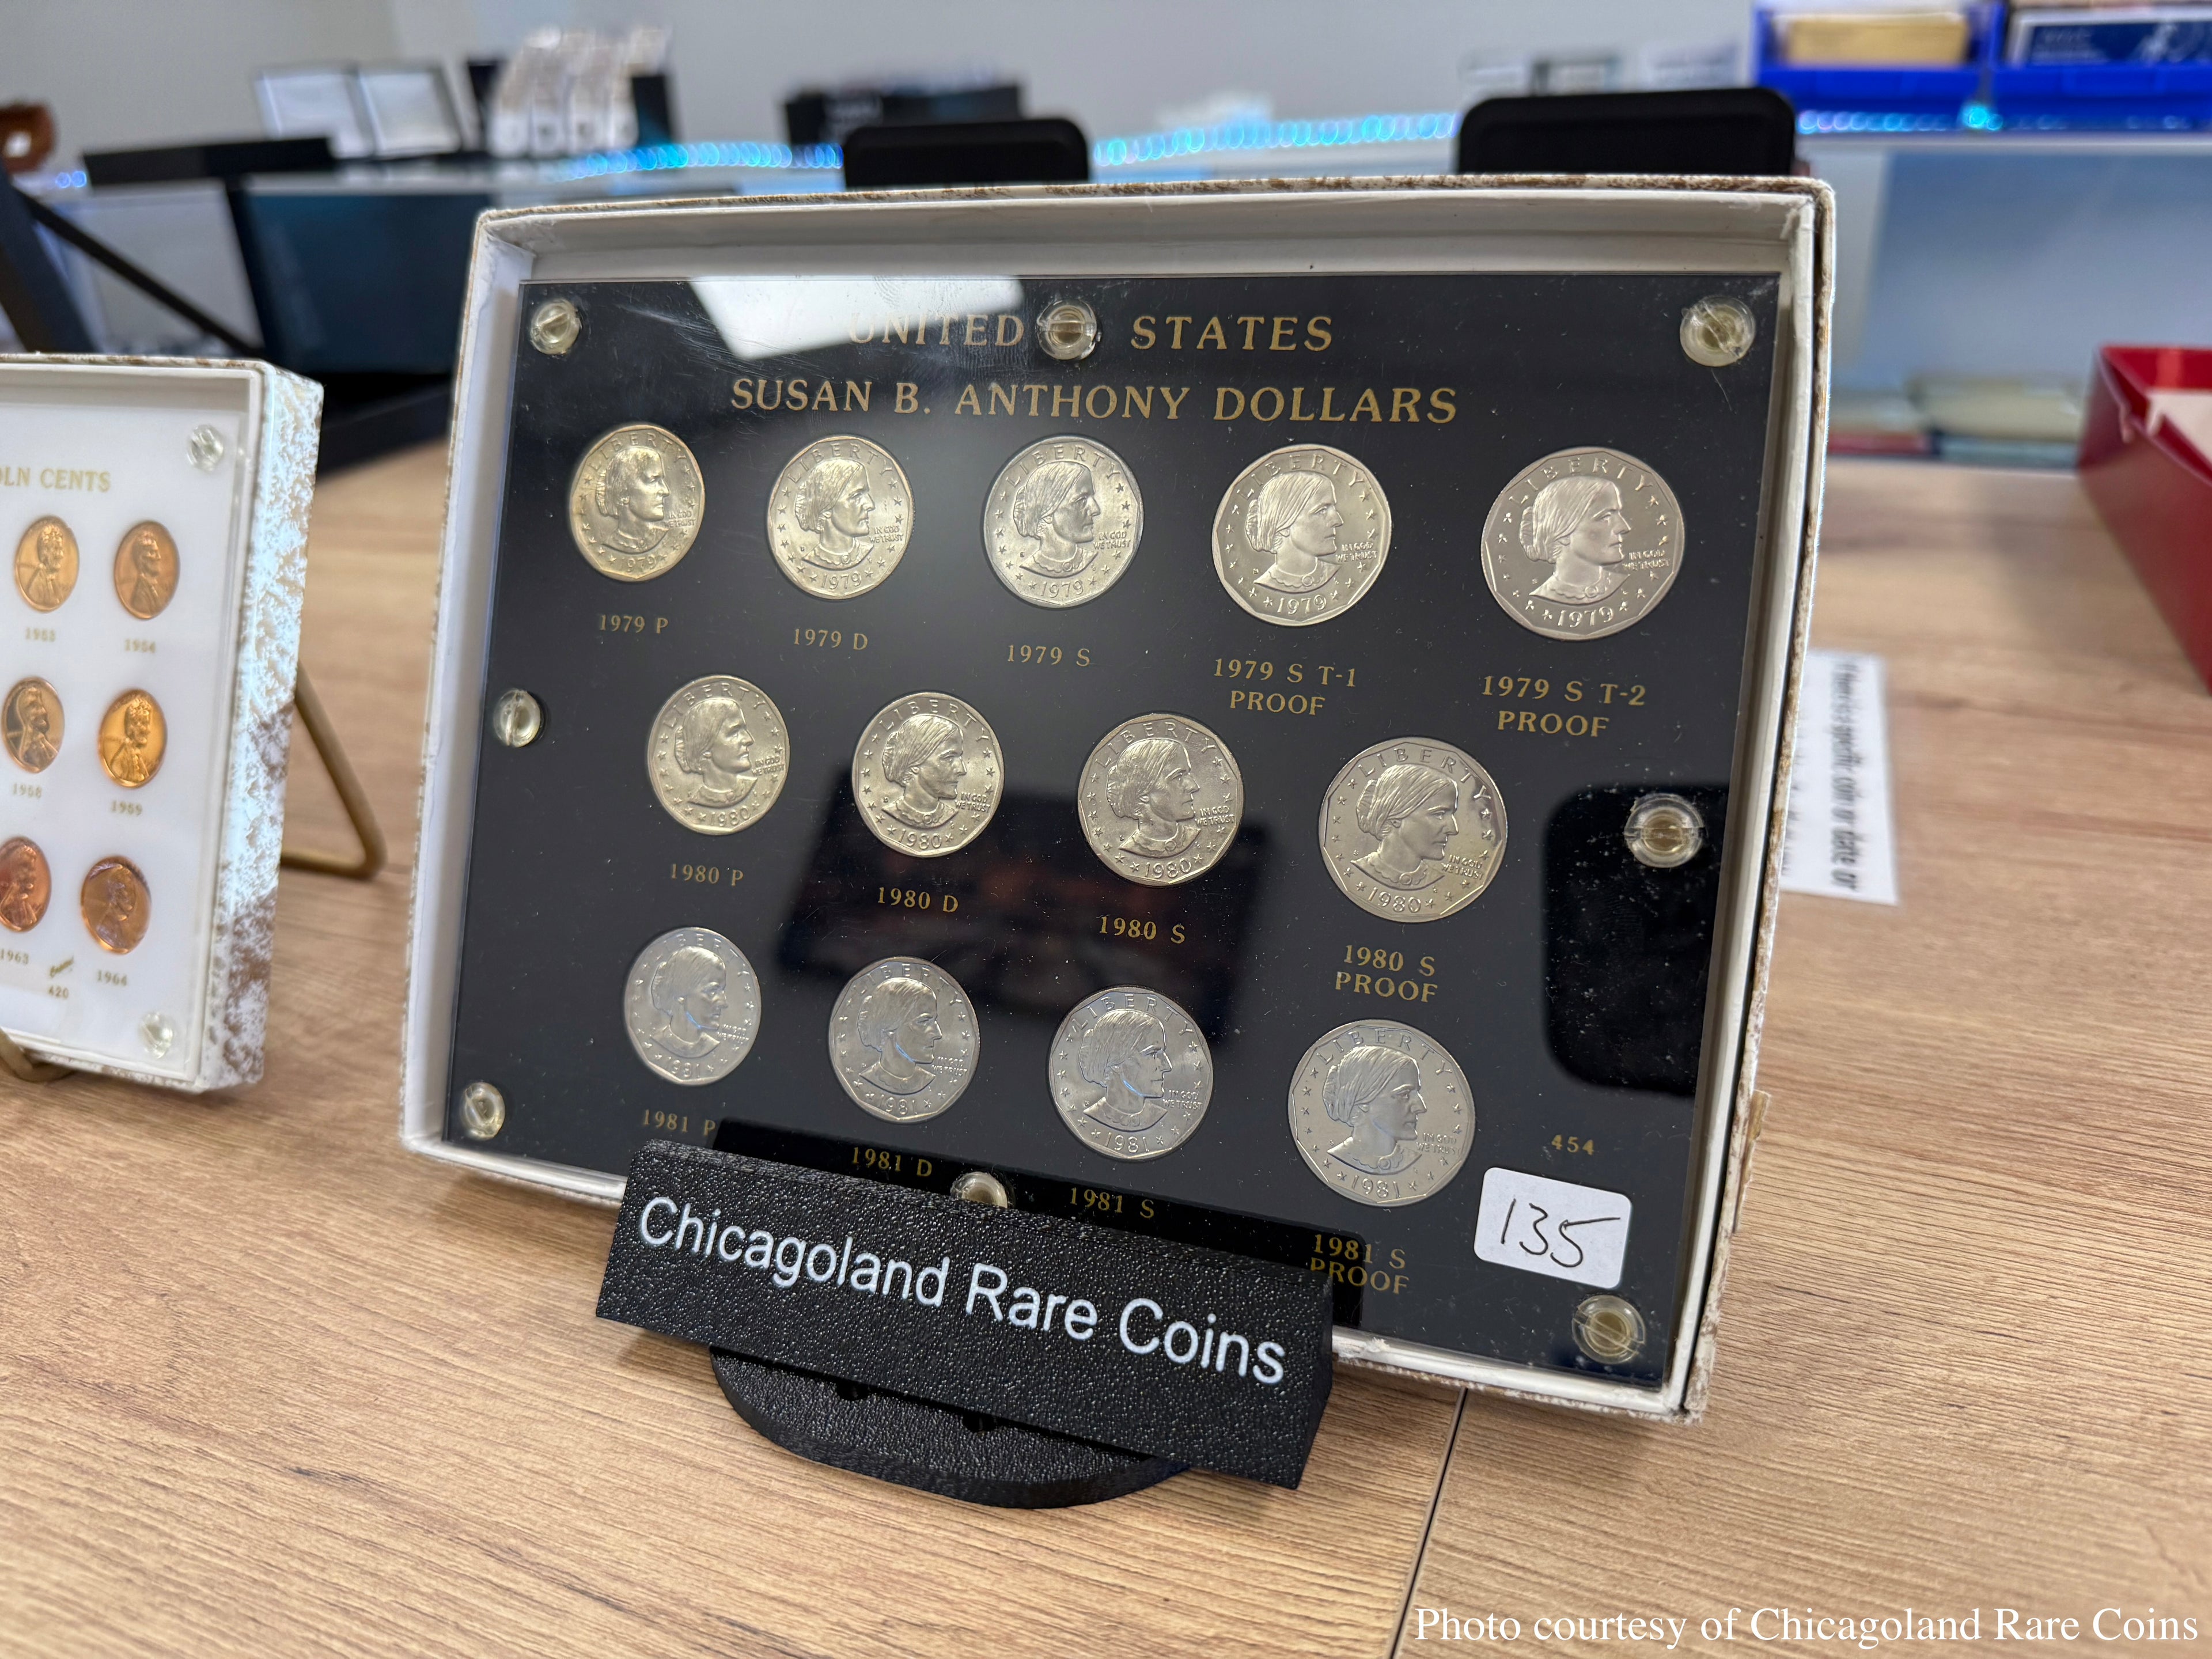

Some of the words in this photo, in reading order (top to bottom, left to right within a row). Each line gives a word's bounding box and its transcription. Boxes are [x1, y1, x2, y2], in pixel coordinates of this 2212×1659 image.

[850, 312, 1024, 346] UNITED
[1130, 315, 1335, 353] STATES
[731, 378, 873, 412] SUSAN
[894, 382, 931, 415] B.
[954, 383, 1190, 421] ANTHONY
[1213, 387, 1459, 425] DOLLARS
[589, 433, 687, 471] LIBERTY
[787, 443, 893, 484] LIBERTY
[1006, 445, 1121, 488] LIBERTY
[0, 465, 31, 487] LN
[40, 468, 111, 493] CENTS
[1236, 453, 1365, 501] LIBERTY
[1508, 457, 1653, 505] LIBERTY
[622, 554, 657, 573] 1979
[821, 571, 862, 590] 1979
[1041, 579, 1084, 599] 1979
[1277, 594, 1327, 615] 1979
[1557, 607, 1613, 628] 1979
[600, 614, 645, 633] 1979
[656, 618, 669, 634] P
[794, 627, 842, 648] 1979
[853, 632, 868, 650] D
[1007, 645, 1063, 666] 1979
[1076, 649, 1091, 666] S
[1214, 658, 1274, 681] 1979
[1286, 664, 1304, 684] S
[1319, 665, 1356, 688] T-1
[662, 682, 766, 728] LIBERTY
[1229, 690, 1325, 716] PROOF
[1482, 675, 1550, 700] 1979
[1564, 681, 1583, 702] S
[1600, 683, 1646, 706] T-2
[878, 699, 990, 742] LIBERTY
[1498, 710, 1609, 737] PROOF
[1094, 722, 1216, 769] LIBERTY
[1358, 748, 1491, 800] LIBERTY
[710, 806, 752, 827] 1980
[898, 828, 942, 850] 1980
[1831, 828, 1866, 865] date
[671, 863, 719, 885] 1980
[731, 869, 744, 887] P
[1145, 858, 1192, 878] 1980
[877, 887, 931, 910] 1980
[942, 895, 959, 913] D
[1368, 886, 1421, 913] 1980
[1099, 915, 1158, 941] 1980
[1171, 923, 1185, 944] S
[1343, 945, 1404, 972] 1980
[1419, 956, 1435, 976] S
[1335, 971, 1438, 1003] PROOF
[1071, 994, 1194, 1036] LIBERTY
[1316, 1029, 1452, 1075] LIBERTY
[643, 1109, 689, 1132] 1981
[704, 1119, 717, 1136] P
[1104, 1132, 1150, 1153] 1981
[1551, 1134, 1594, 1156] 454
[852, 1147, 902, 1172] 1981
[916, 1159, 933, 1177] D
[1351, 1175, 1400, 1199] 1981
[1070, 1187, 1123, 1214] 1981
[1140, 1199, 1154, 1218] S
[1501, 1198, 1620, 1268] 135
[1314, 1233, 1373, 1264] 1981
[1389, 1249, 1406, 1270] S
[638, 1195, 950, 1308] Chicagoland
[965, 1261, 1098, 1340] Rare
[1118, 1296, 1287, 1385] Coins
[1310, 1257, 1410, 1294] PROOF
